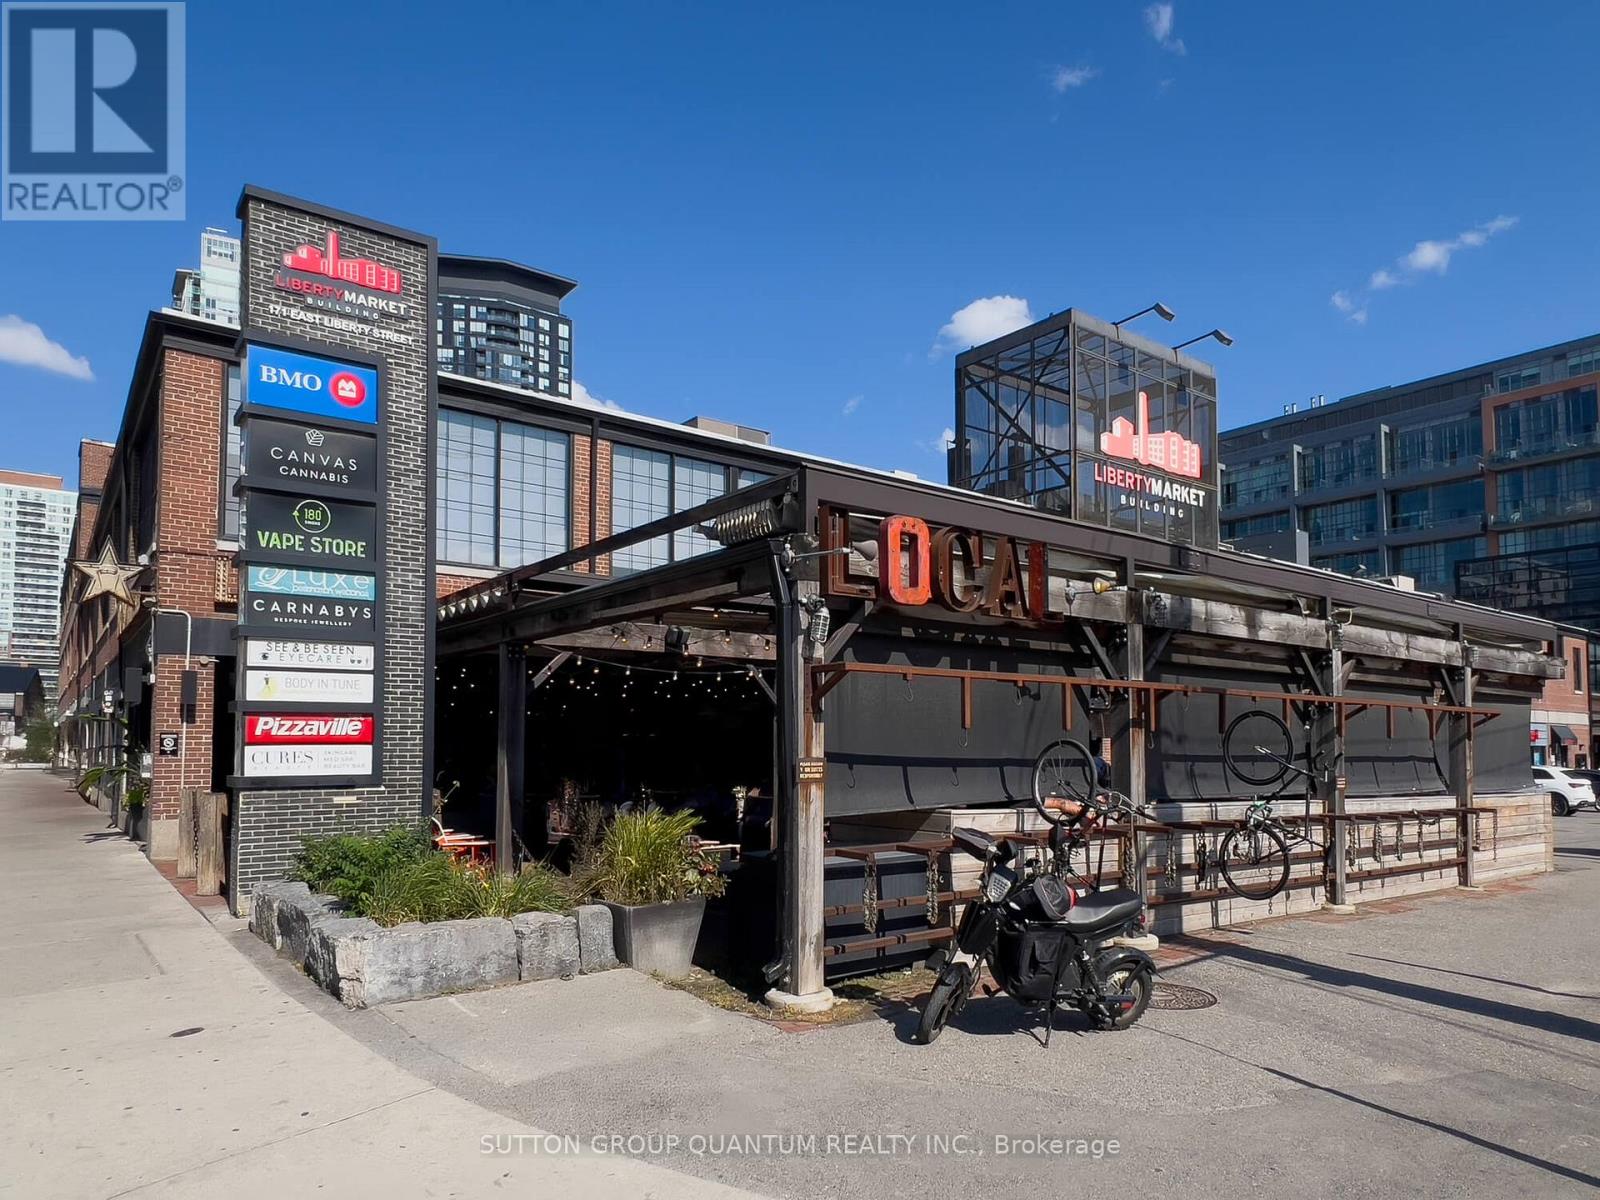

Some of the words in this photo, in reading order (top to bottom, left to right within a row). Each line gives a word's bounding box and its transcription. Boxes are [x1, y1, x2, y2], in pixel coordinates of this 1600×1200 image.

[306, 296, 379, 320] BUILDING
[268, 304, 288, 318] 171
[289, 309, 321, 325] EAST
[323, 316, 372, 336] LIBERTY
[372, 327, 414, 346] STREET
[259, 364, 322, 391] BMO
[270, 446, 357, 471] CANVAS
[279, 465, 349, 484] CANNABIS
[1094, 462, 1206, 507] LIBERTYMARKET
[1120, 494, 1184, 519] BUILDING
[257, 530, 305, 552] VAPE
[310, 536, 367, 558] STORE
[817, 507, 1064, 622] LOCAL
[252, 599, 372, 619] CARNABYS
[274, 617, 308, 625] BESPOKE
[266, 641, 288, 653] SEE
[292, 643, 300, 653] &
[304, 643, 320, 654] BE
[323, 644, 355, 655] SEEN
[279, 652, 342, 664] EYECARE
[284, 677, 315, 689] BODY
[318, 678, 329, 689] IN
[330, 679, 361, 690] TUNE
[254, 716, 363, 736] Pizzaville
